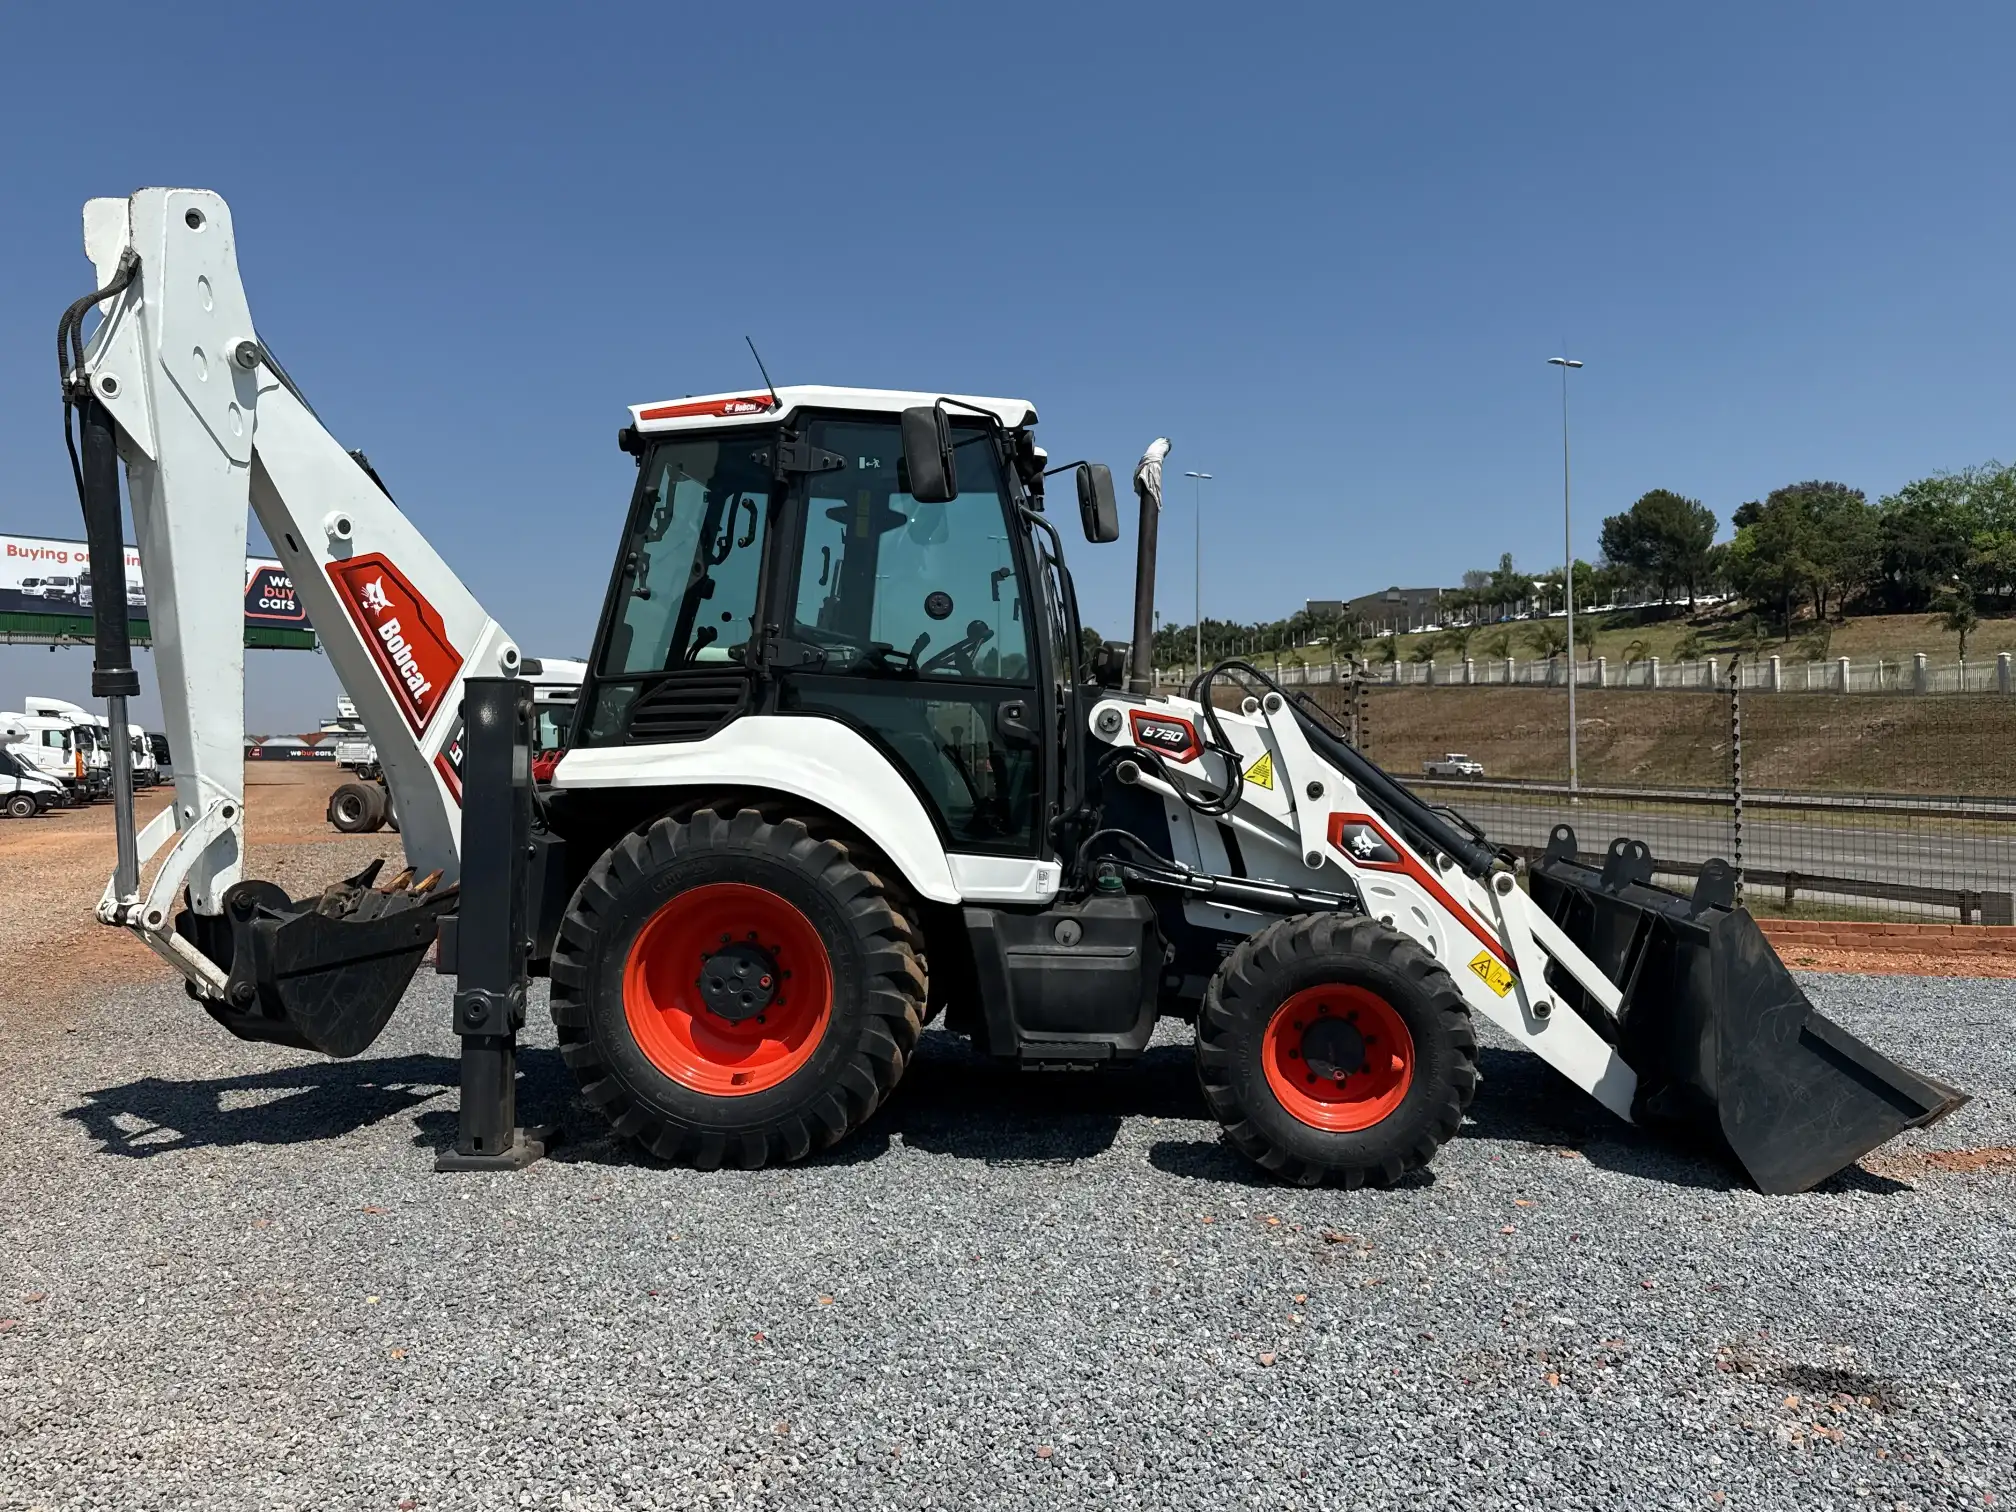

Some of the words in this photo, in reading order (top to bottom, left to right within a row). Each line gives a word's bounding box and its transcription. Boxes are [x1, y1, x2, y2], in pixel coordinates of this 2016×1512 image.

[734, 402, 757, 412] Bobcat
[6, 544, 68, 564] Buying
[269, 575, 293, 588] we
[264, 584, 295, 600] buy
[259, 598, 295, 611] cars
[378, 617, 432, 701] Bobcat
[1142, 726, 1184, 742] B730
